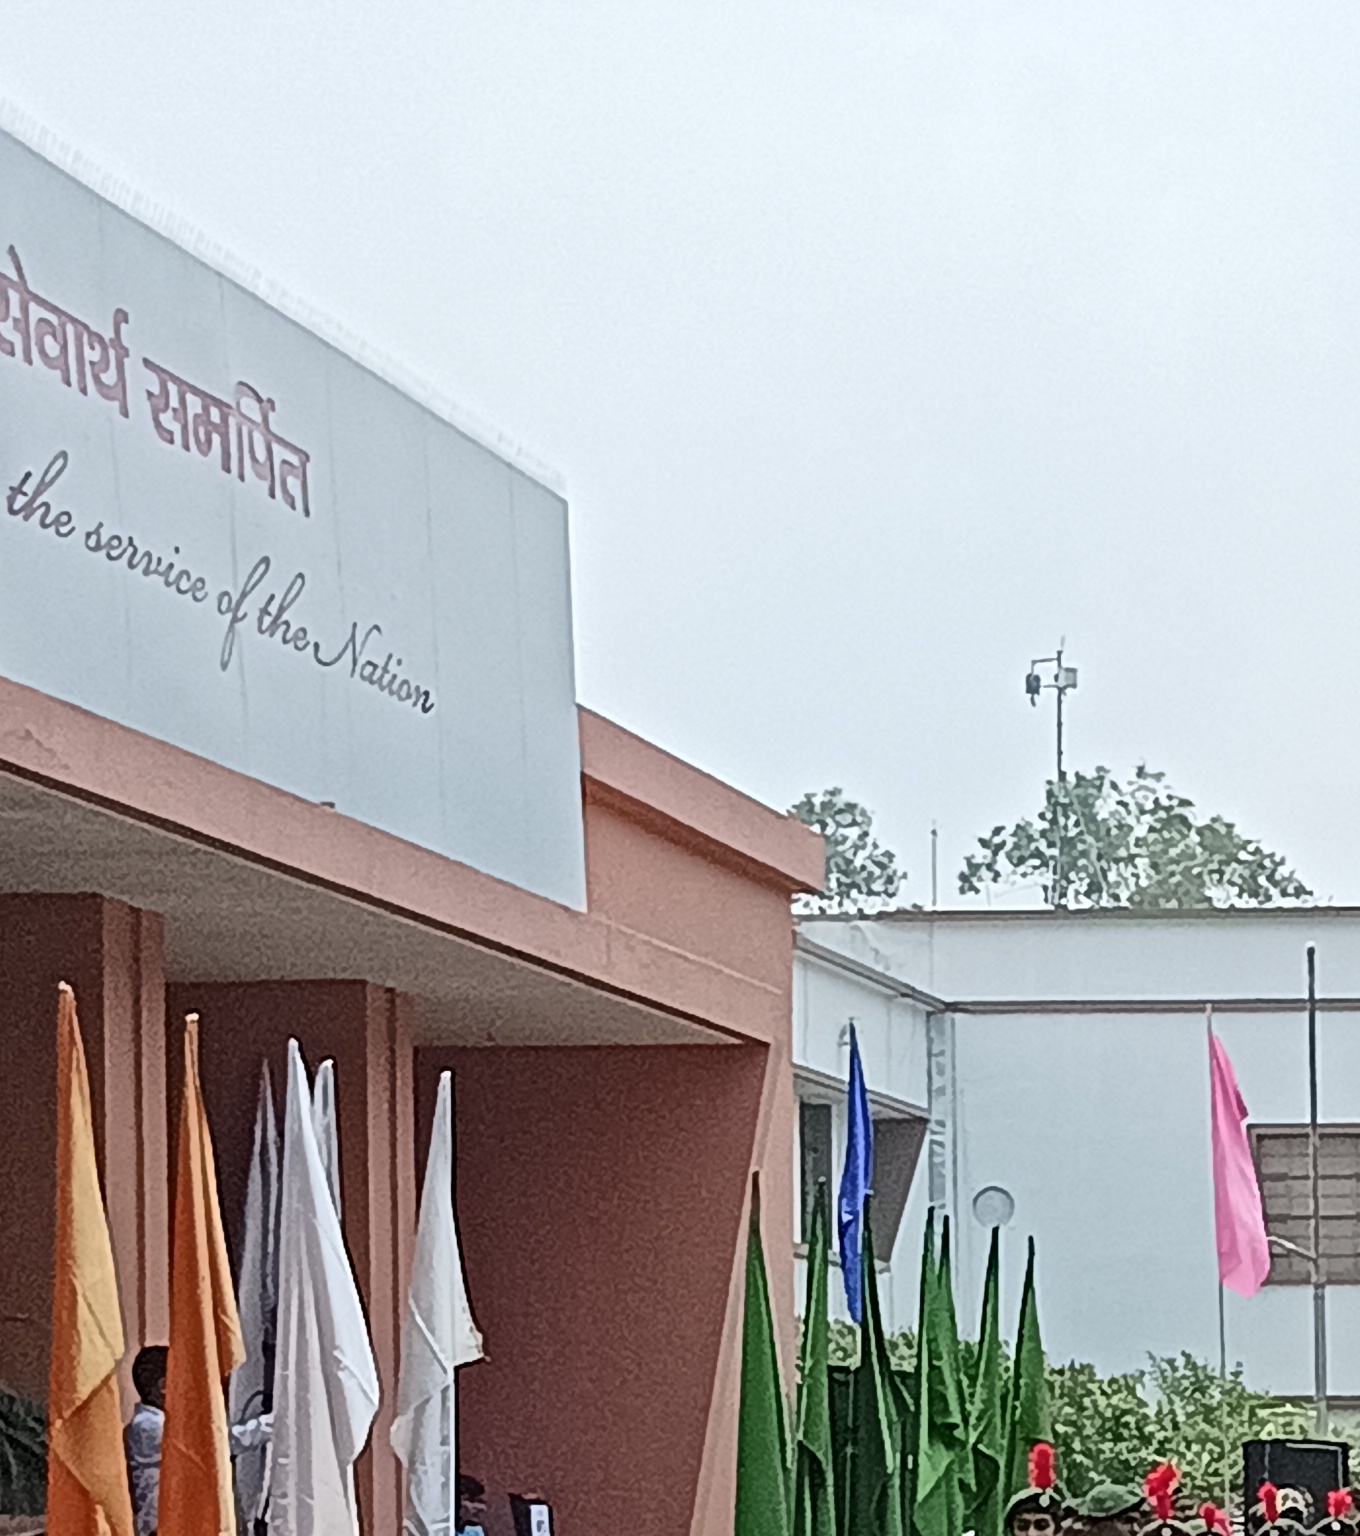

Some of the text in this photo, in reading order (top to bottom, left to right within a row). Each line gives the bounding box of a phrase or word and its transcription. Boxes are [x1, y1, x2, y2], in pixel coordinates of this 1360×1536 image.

[142, 357, 311, 518] समर्पित
[6, 450, 435, 714] the service of the Nation
